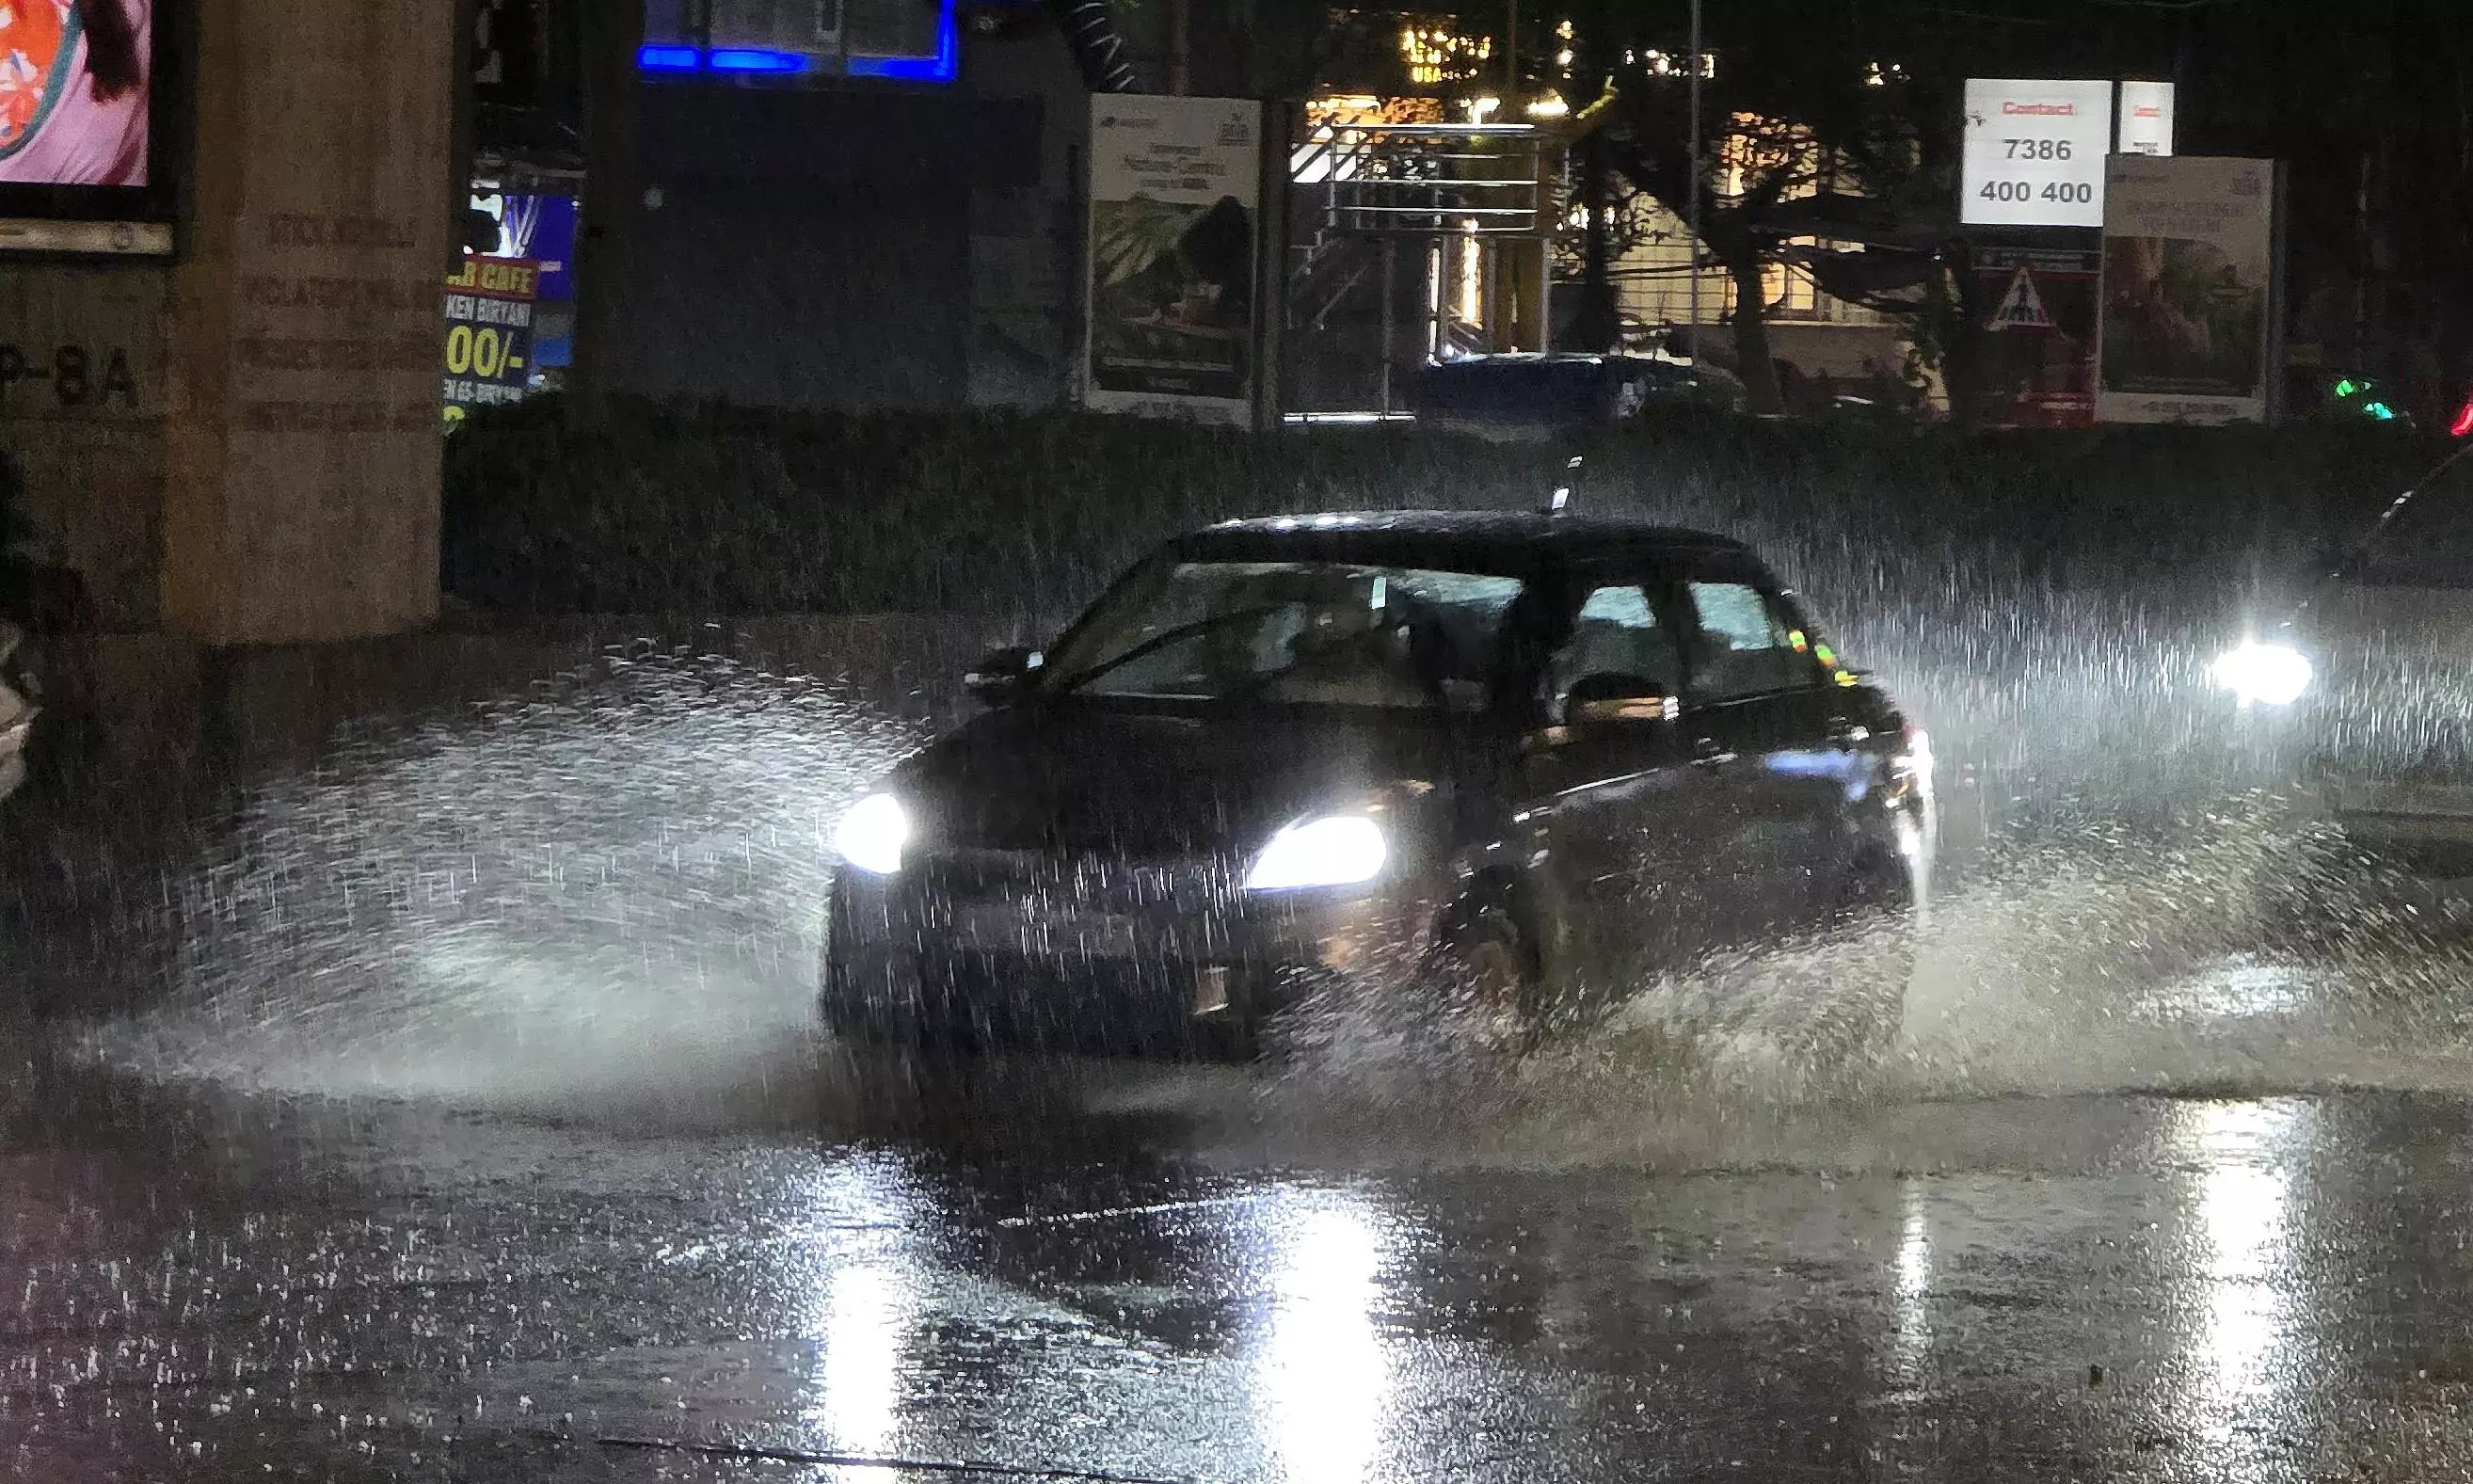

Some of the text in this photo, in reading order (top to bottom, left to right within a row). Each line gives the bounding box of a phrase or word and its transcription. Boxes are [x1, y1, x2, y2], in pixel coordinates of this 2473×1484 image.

[2002, 138, 2072, 161] 7386
[1980, 180, 2093, 204] 400 400
[481, 263, 534, 294] CAFE
